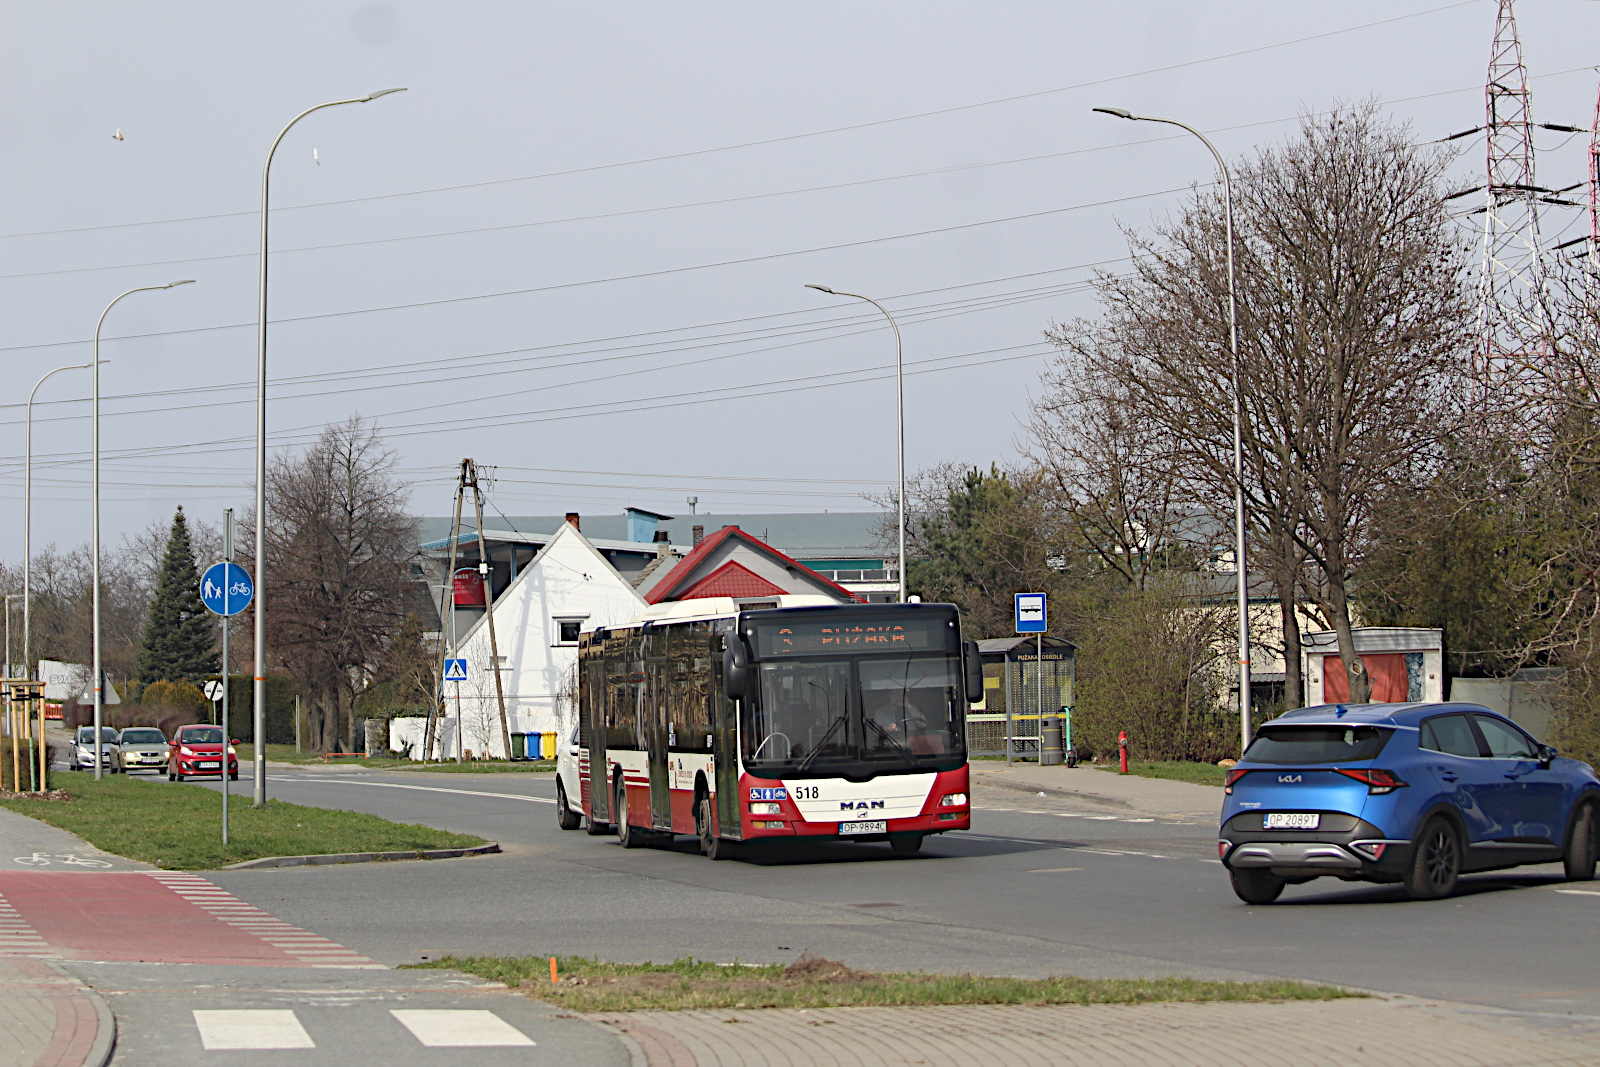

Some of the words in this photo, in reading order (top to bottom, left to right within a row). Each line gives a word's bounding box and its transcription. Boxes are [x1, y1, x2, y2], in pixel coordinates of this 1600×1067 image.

[796, 786, 819, 800] 518
[840, 800, 885, 811] MAN
[1269, 814, 1283, 826] OP
[1285, 814, 1317, 826] 2089T
[844, 822, 857, 833] OP
[859, 821, 886, 832] 9894C
